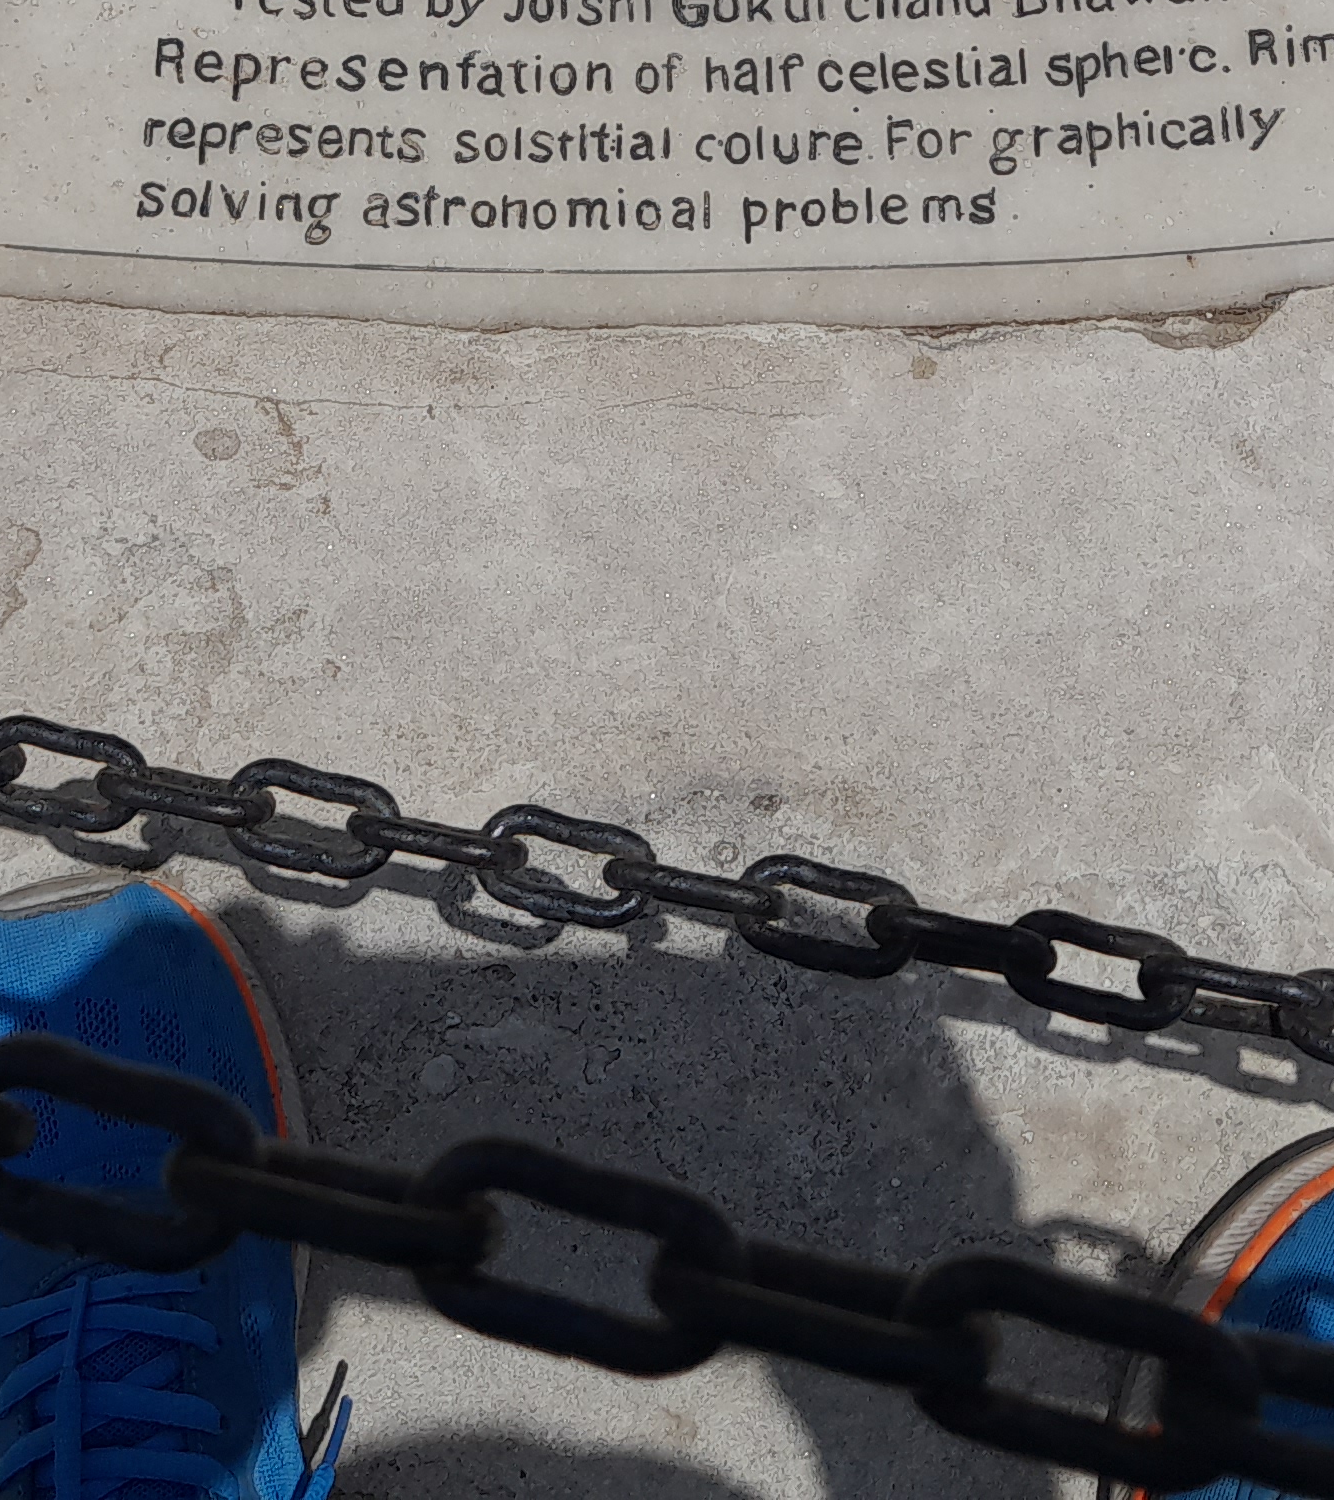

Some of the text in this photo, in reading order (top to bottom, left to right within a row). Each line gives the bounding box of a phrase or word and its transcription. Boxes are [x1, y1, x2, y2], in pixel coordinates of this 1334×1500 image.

[635, 52, 684, 94] of
[704, 53, 805, 96] half
[142, 117, 427, 165] represents
[886, 114, 973, 160] For
[988, 103, 1286, 176] graphically
